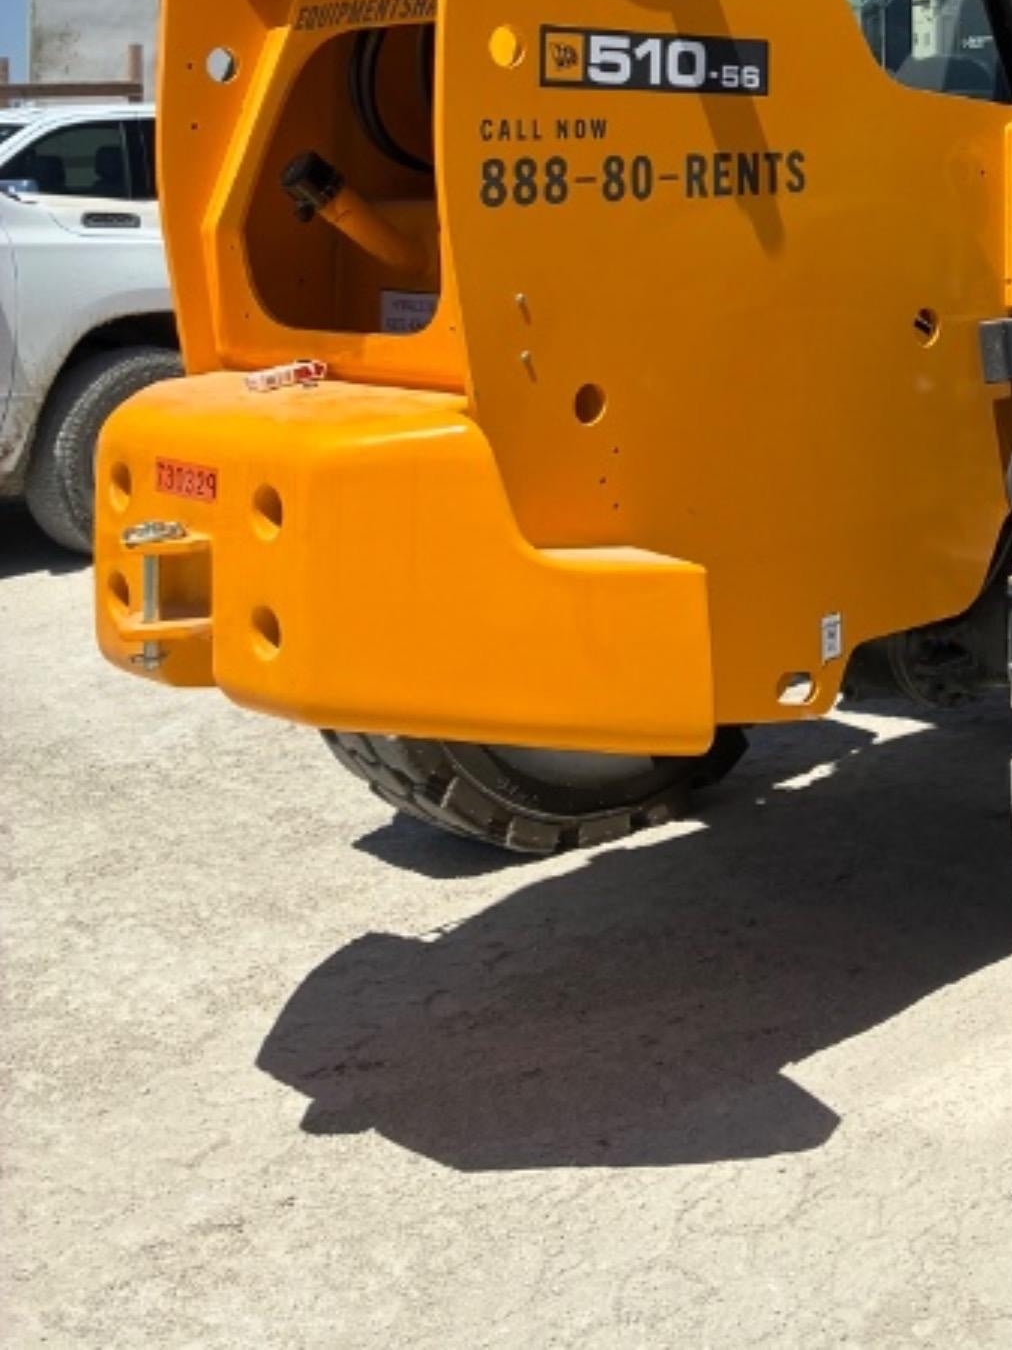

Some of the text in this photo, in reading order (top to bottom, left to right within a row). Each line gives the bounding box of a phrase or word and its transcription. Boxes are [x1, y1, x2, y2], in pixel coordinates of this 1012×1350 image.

[480, 119, 608, 141] CALL NOW
[480, 151, 806, 208] 888-80-RENTS
